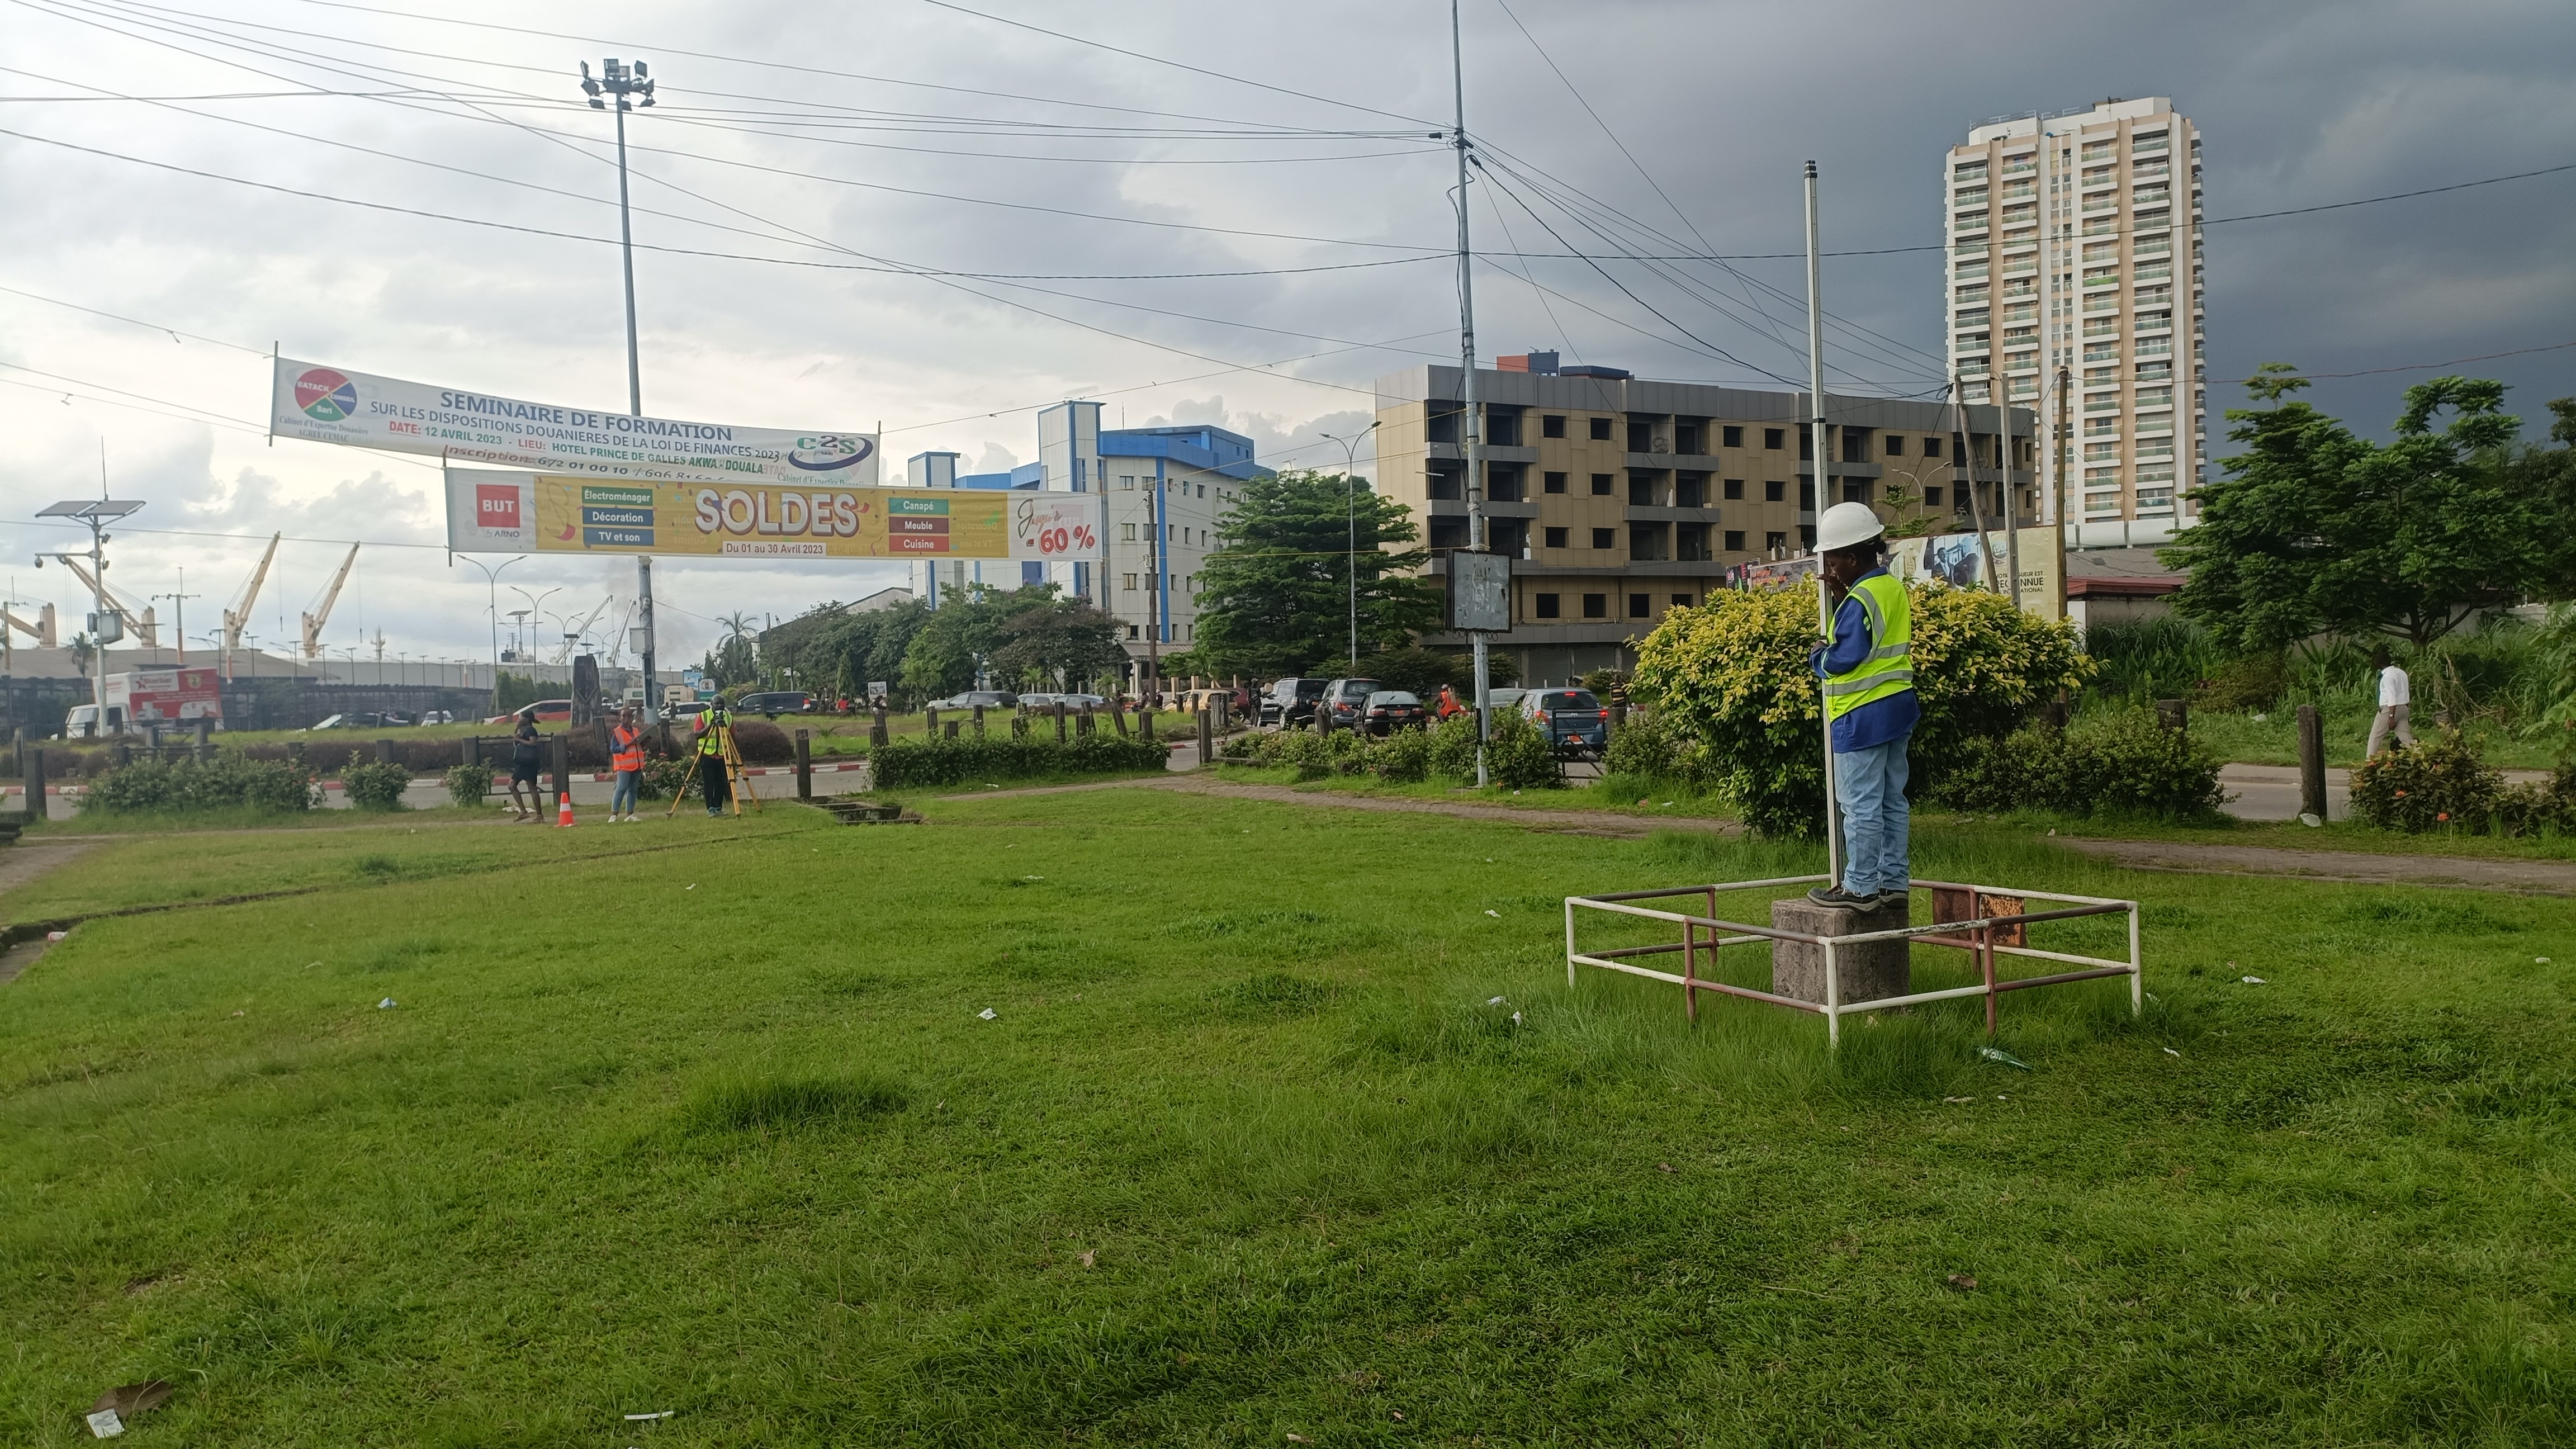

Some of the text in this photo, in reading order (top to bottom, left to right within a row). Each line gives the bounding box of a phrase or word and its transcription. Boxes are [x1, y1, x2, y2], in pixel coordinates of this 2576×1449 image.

[297, 381, 330, 392] BATACK
[330, 394, 356, 403] CONSEIL
[280, 415, 302, 426] Cabinet
[441, 392, 732, 441] SEMINAIRE DE FORMATION
[324, 432, 349, 442] CEMAC
[371, 401, 397, 416] SUR
[402, 406, 425, 420] LES
[429, 411, 522, 434] DISPOSITIONS
[527, 425, 609, 444] DOUANIERES
[613, 435, 629, 447] DE
[633, 438, 648, 448] LA
[652, 439, 671, 450] LOI
[675, 442, 690, 452] DE
[694, 443, 752, 457] FINANCES
[755, 450, 780, 462] 2023
[390, 421, 421, 435] DATE:
[425, 426, 437, 437] 12
[441, 429, 473, 441] AVRIL
[477, 433, 502, 444] 2023
[518, 439, 546, 450] LIEU:
[552, 443, 587, 455] HOTEL
[590, 448, 628, 460] PRINCE
[632, 452, 645, 461] DE
[648, 453, 686, 465] GALLES
[688, 457, 717, 469] AKWA
[726, 460, 763, 474] DOUALA
[797, 435, 856, 454] C2S
[538, 457, 564, 468] 672
[778, 472, 802, 482] Cabinet
[584, 489, 650, 503] Électroménager
[482, 499, 514, 513] BUT
[903, 501, 934, 512] Canapé
[593, 511, 643, 522] Décoration
[695, 489, 859, 538] SOLDES
[905, 521, 933, 529] Meuble
[599, 532, 612, 541] TV
[614, 533, 623, 541] et
[727, 543, 738, 552] Du
[741, 544, 751, 552] 01
[768, 544, 778, 553] 30
[780, 544, 801, 553] Avril
[803, 545, 823, 553] 2023
[903, 539, 934, 548] Cuisine
[1993, 544, 2006, 553] ISO
